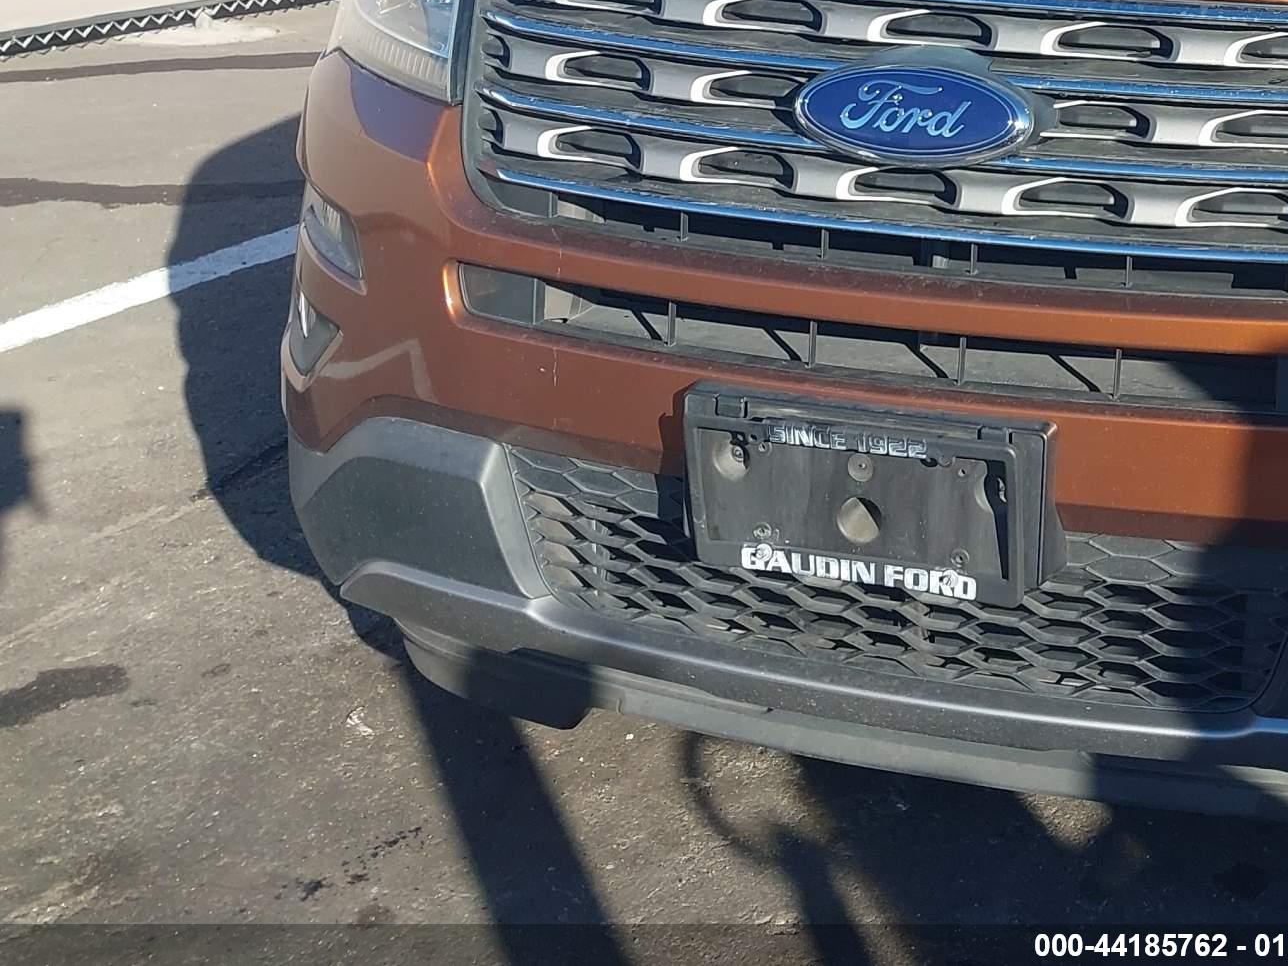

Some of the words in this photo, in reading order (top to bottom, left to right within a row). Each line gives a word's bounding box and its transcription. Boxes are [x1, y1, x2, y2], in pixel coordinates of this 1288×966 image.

[840, 79, 972, 138] Ford
[767, 424, 847, 450] SINCE
[855, 433, 928, 459] 1922
[740, 544, 876, 586] GAUDIN
[884, 565, 977, 601] FORD
